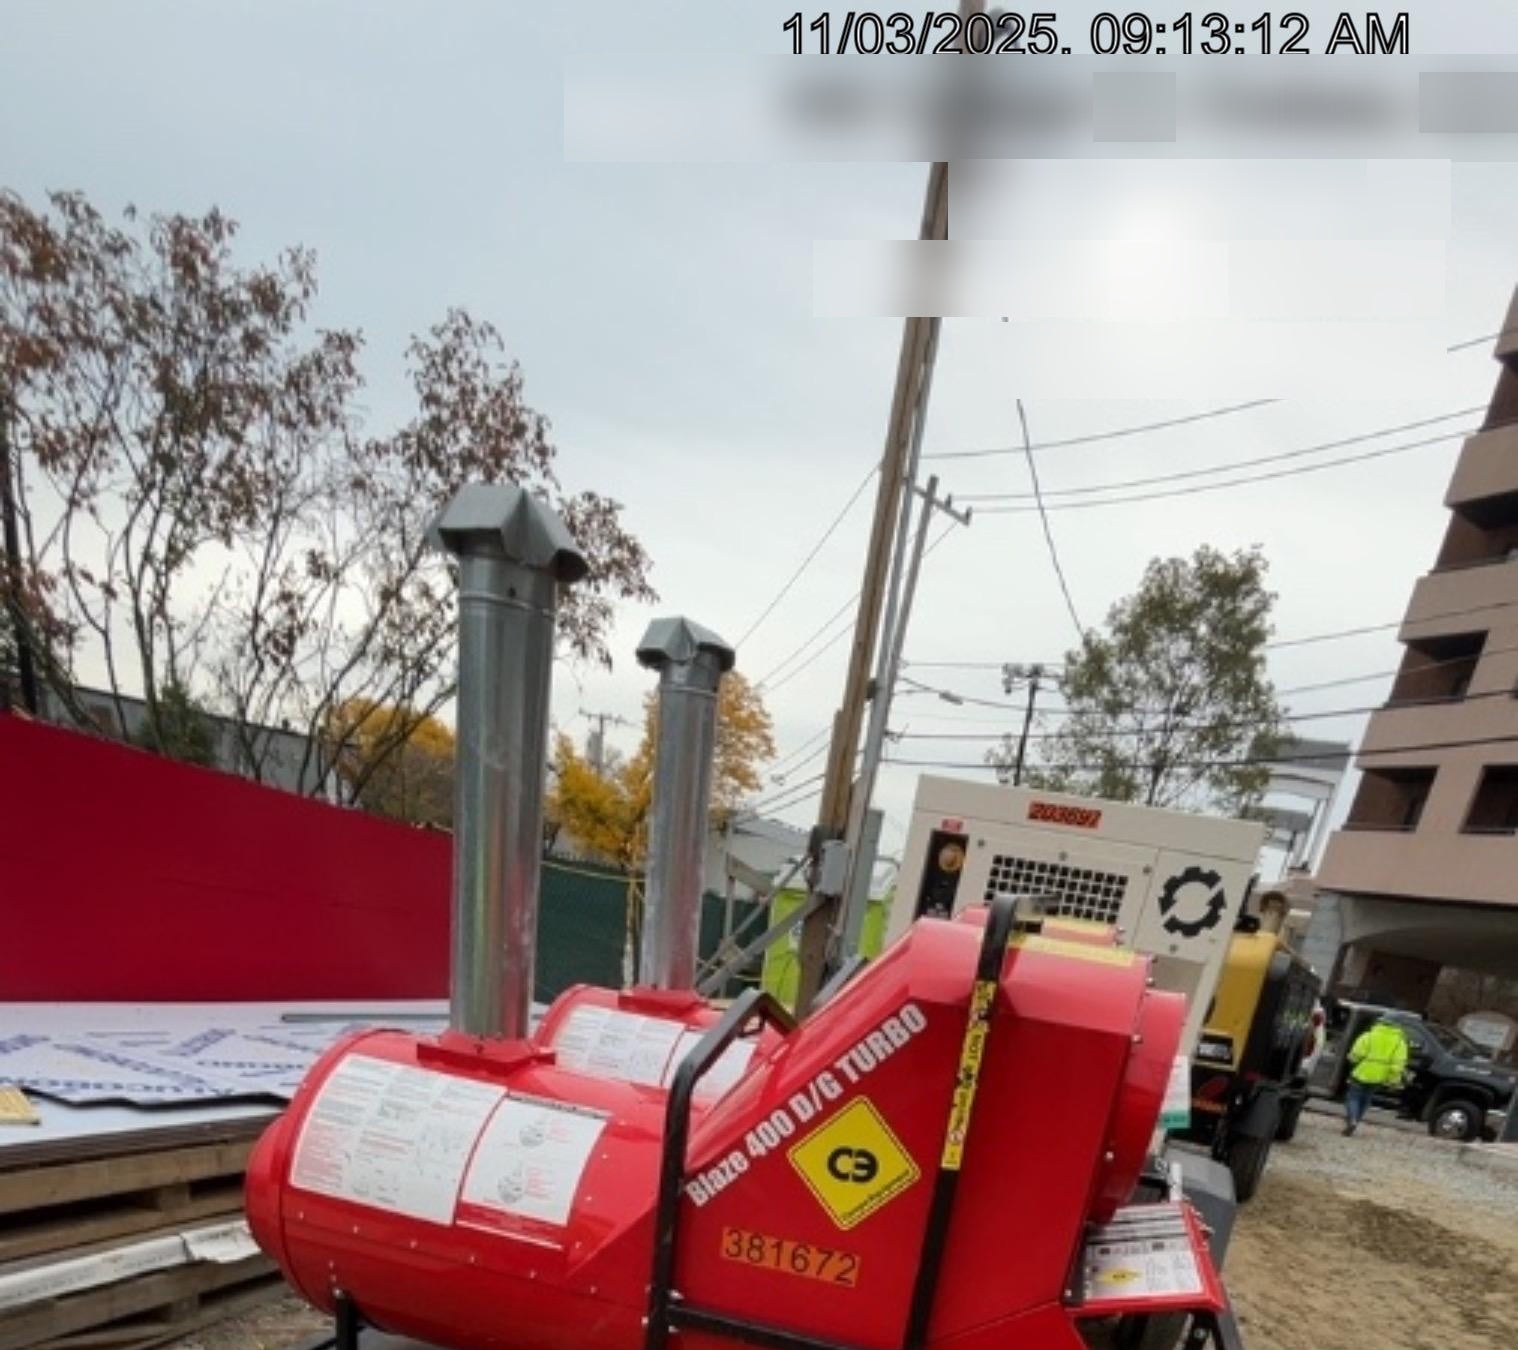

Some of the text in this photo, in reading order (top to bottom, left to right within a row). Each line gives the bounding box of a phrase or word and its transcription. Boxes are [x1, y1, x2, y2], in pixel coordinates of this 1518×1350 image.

[685, 1151, 750, 1207] Blaze
[745, 1109, 796, 1157] 400
[788, 1071, 844, 1123] D/G
[834, 1003, 928, 1084] TURBO
[725, 1228, 857, 1286] 381672
